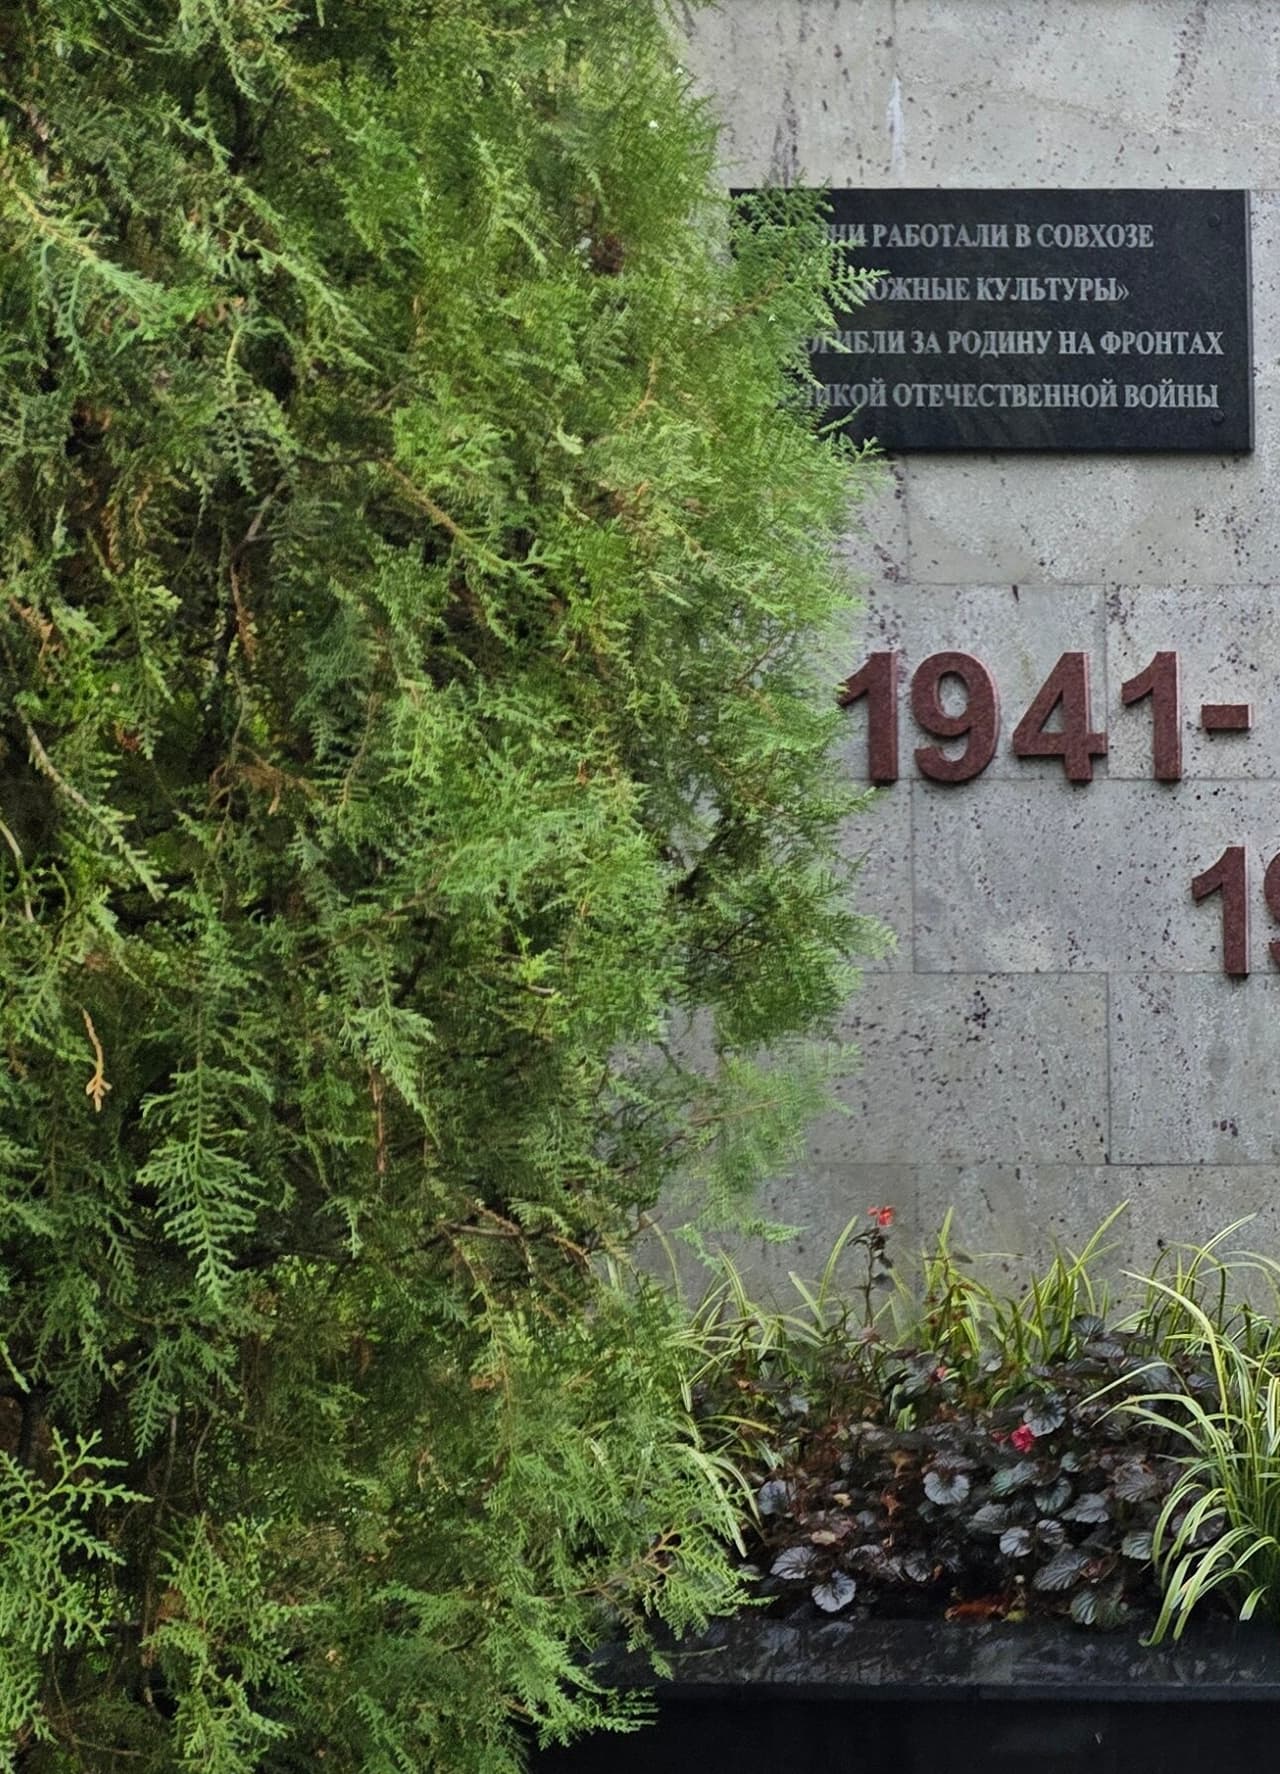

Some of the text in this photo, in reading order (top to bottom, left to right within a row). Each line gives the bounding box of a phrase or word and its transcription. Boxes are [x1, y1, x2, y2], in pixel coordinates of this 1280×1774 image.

[872, 223, 1008, 248] РАБОТАЛИ
[1015, 224, 1031, 248] В
[1037, 223, 1154, 248] СОВХОЗЕ
[976, 276, 1130, 301] КУЛЬТУРЫ»
[911, 331, 941, 355] ЗА
[948, 331, 1052, 358] РОДИНУ
[1058, 331, 1096, 355] НА
[1099, 331, 1225, 355] ФРОНТАХ
[892, 378, 1119, 408] ОТЕЧЕСТВЕННОЙ
[1123, 378, 1220, 408] ВОЙНЫ
[838, 651, 1252, 783] 1941-
